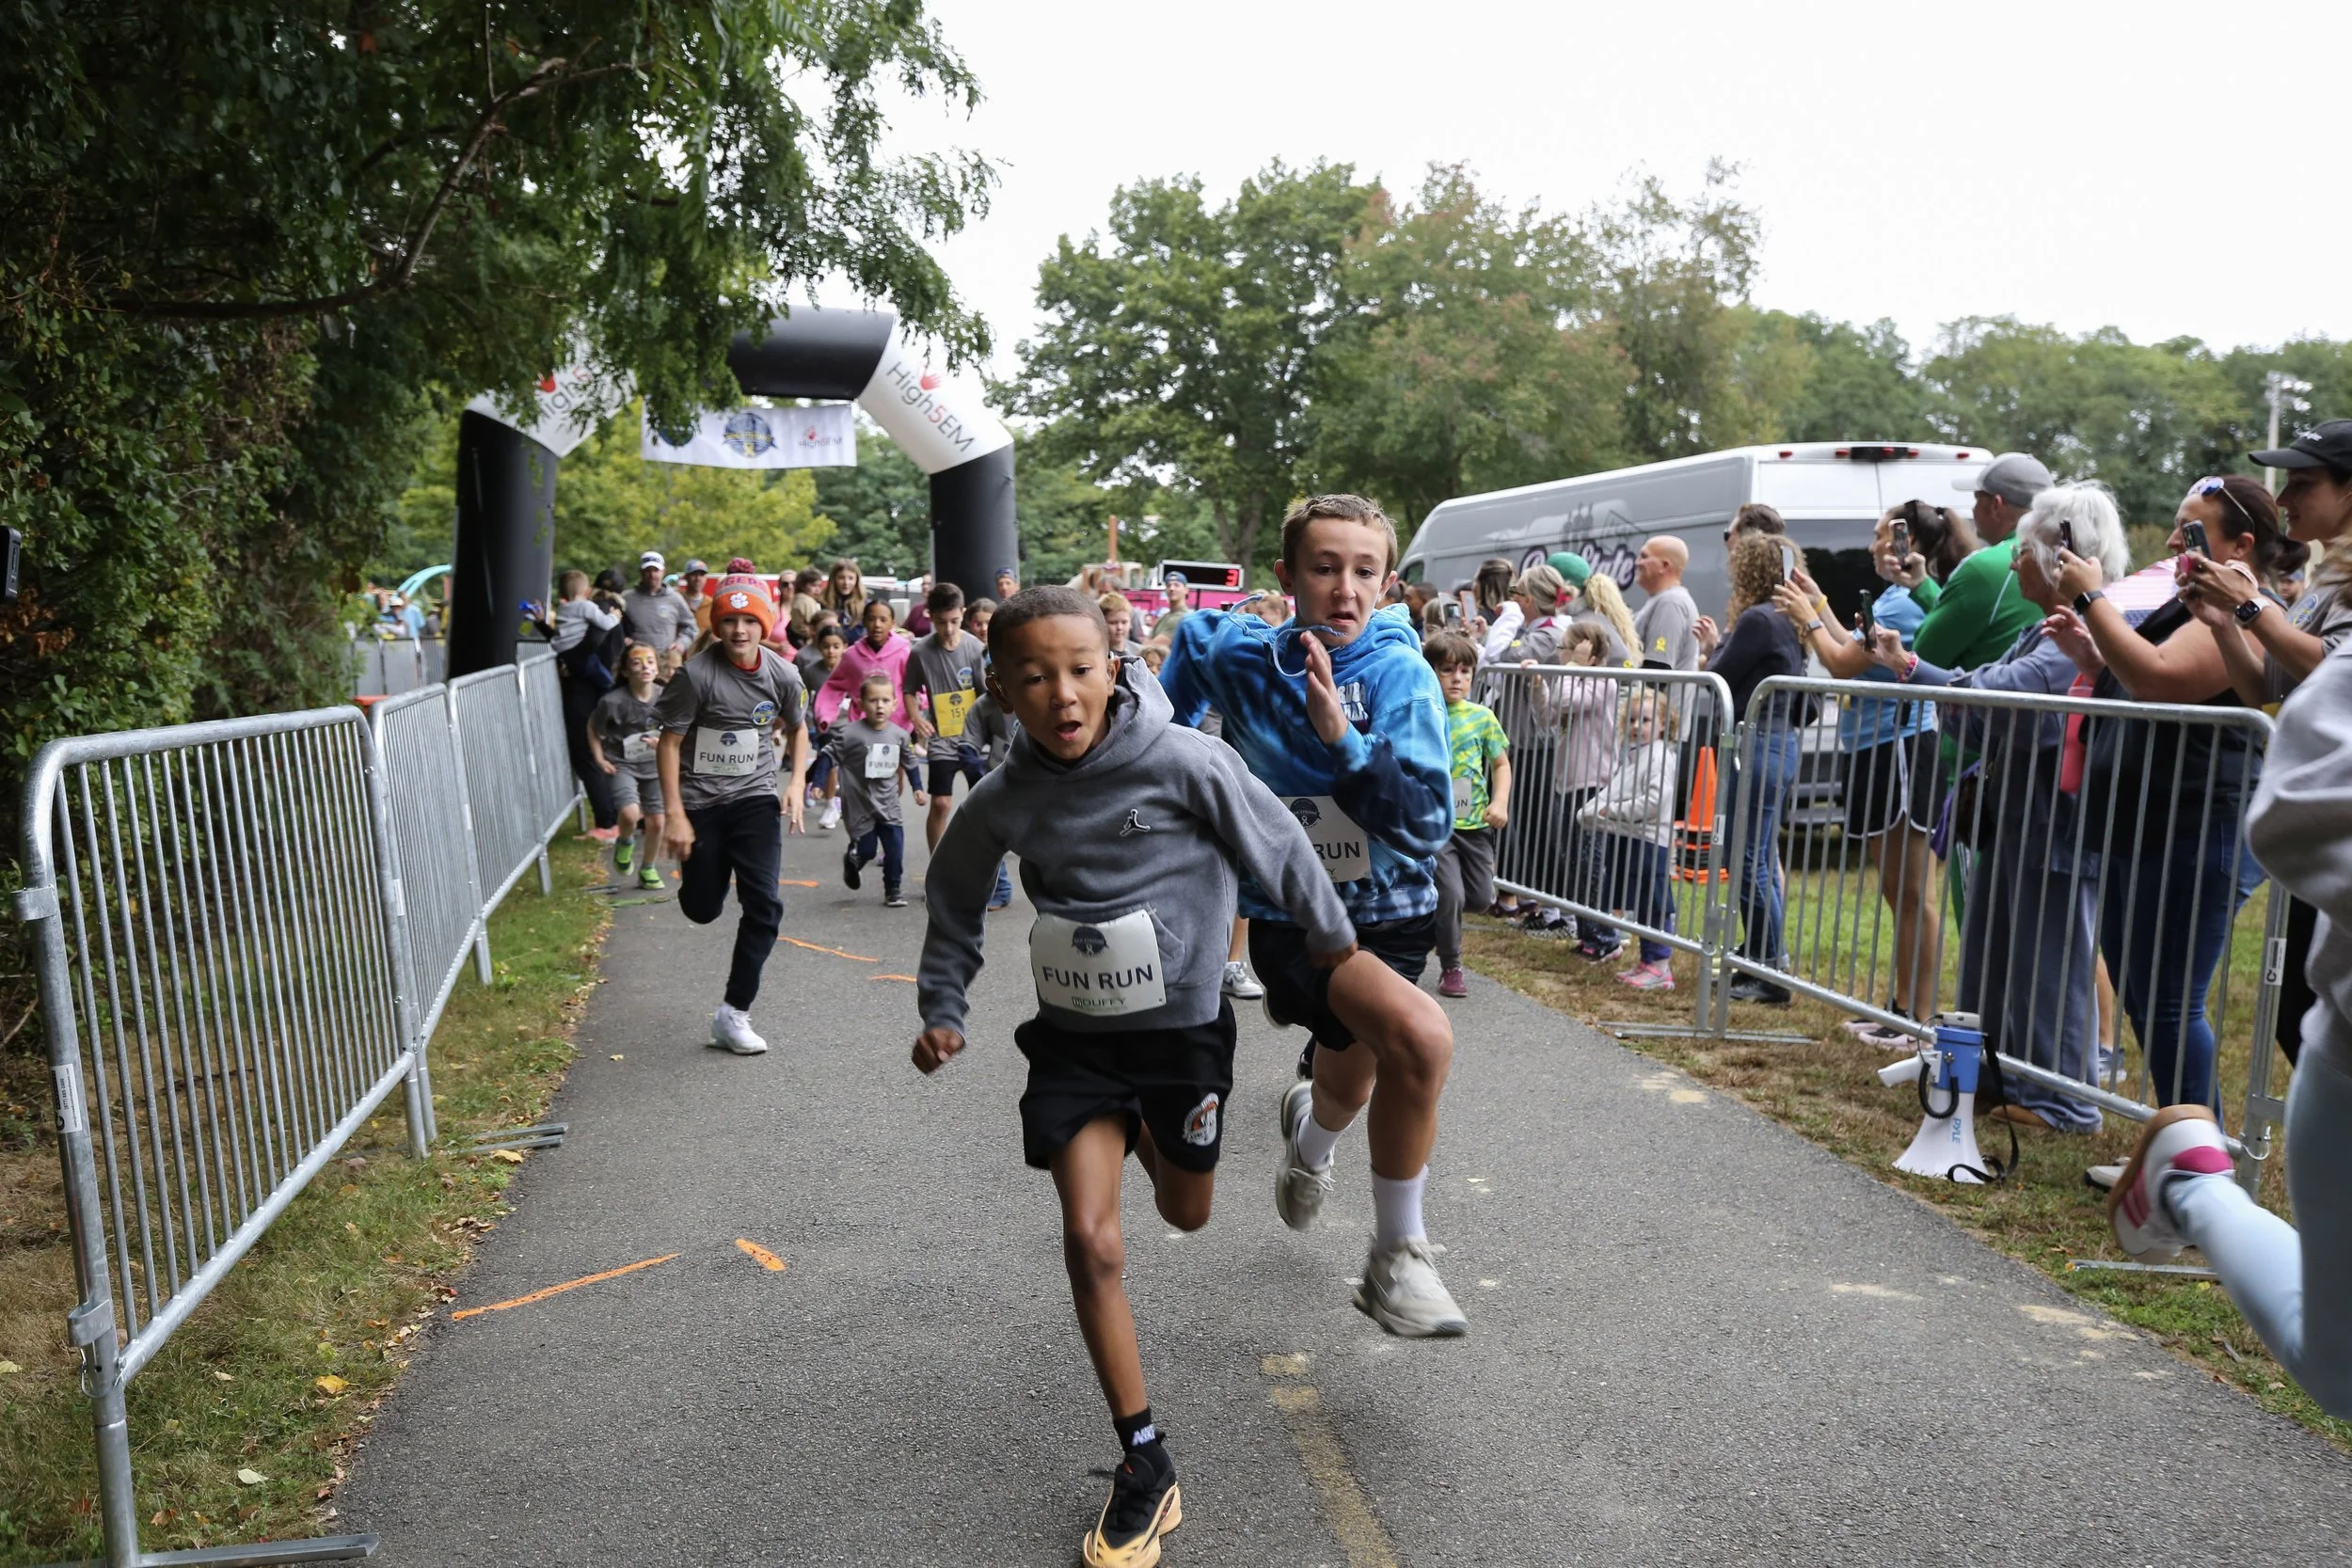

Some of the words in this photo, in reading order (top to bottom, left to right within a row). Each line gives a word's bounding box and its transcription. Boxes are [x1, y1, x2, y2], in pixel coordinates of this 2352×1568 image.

[886, 361, 975, 451] High5EM
[700, 752, 724, 763] FUN
[729, 753, 754, 764] RUN
[1312, 842, 1360, 860] RUN
[1041, 966, 1089, 990] FUN
[1098, 963, 1153, 990] RUN
[1952, 1117, 1962, 1144] PYLE
